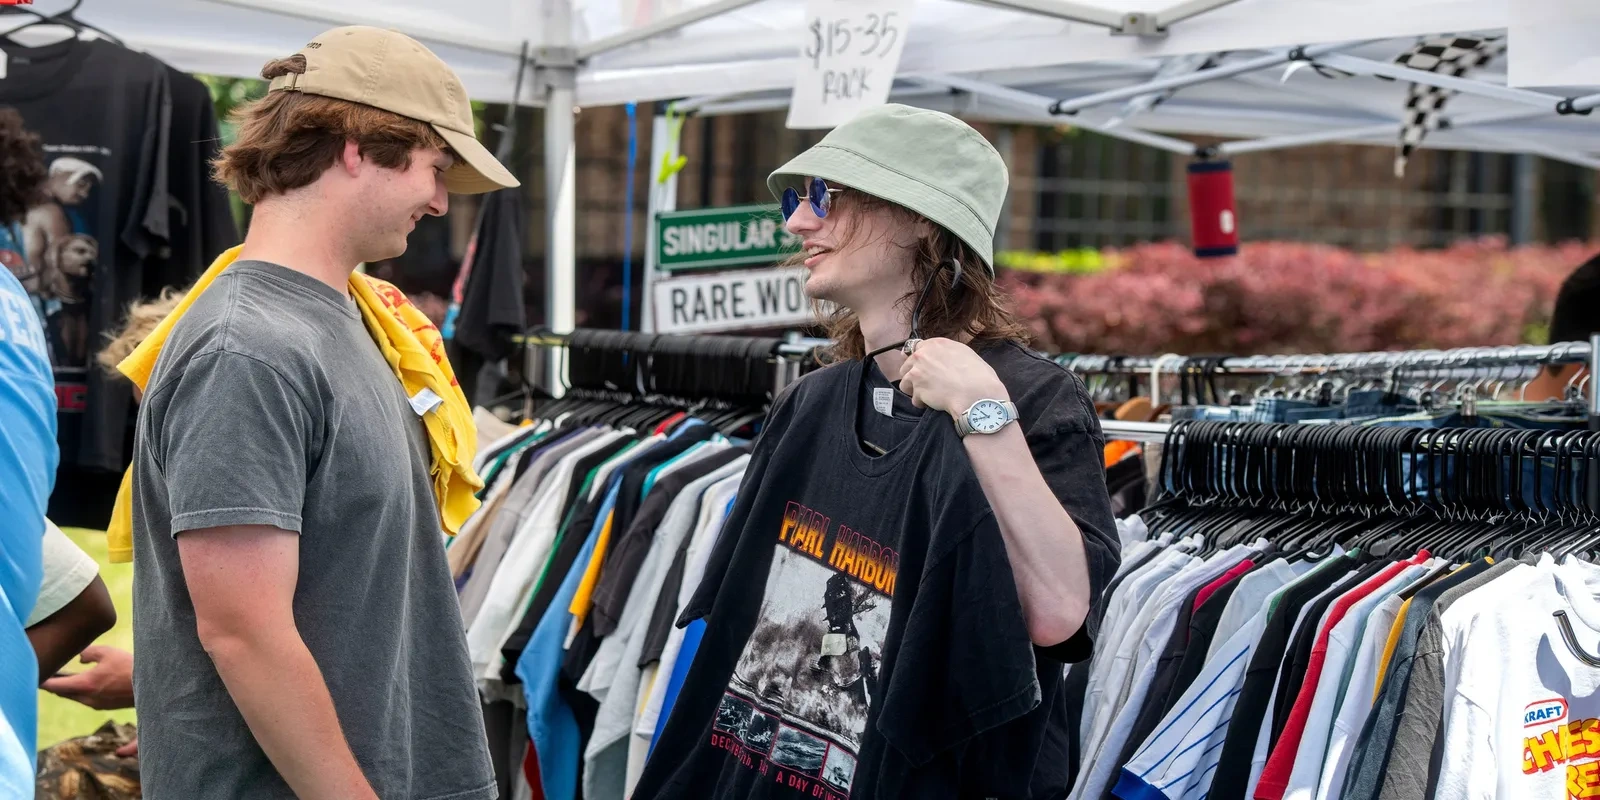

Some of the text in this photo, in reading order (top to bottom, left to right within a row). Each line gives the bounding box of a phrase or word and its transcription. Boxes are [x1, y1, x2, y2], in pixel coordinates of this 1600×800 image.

[805, 11, 897, 69] $15-35
[663, 219, 776, 256] SINGULAR
[671, 277, 809, 325] RARE.WO
[776, 771, 783, 783] A
[788, 774, 809, 792] DAY
[812, 784, 825, 798] OF
